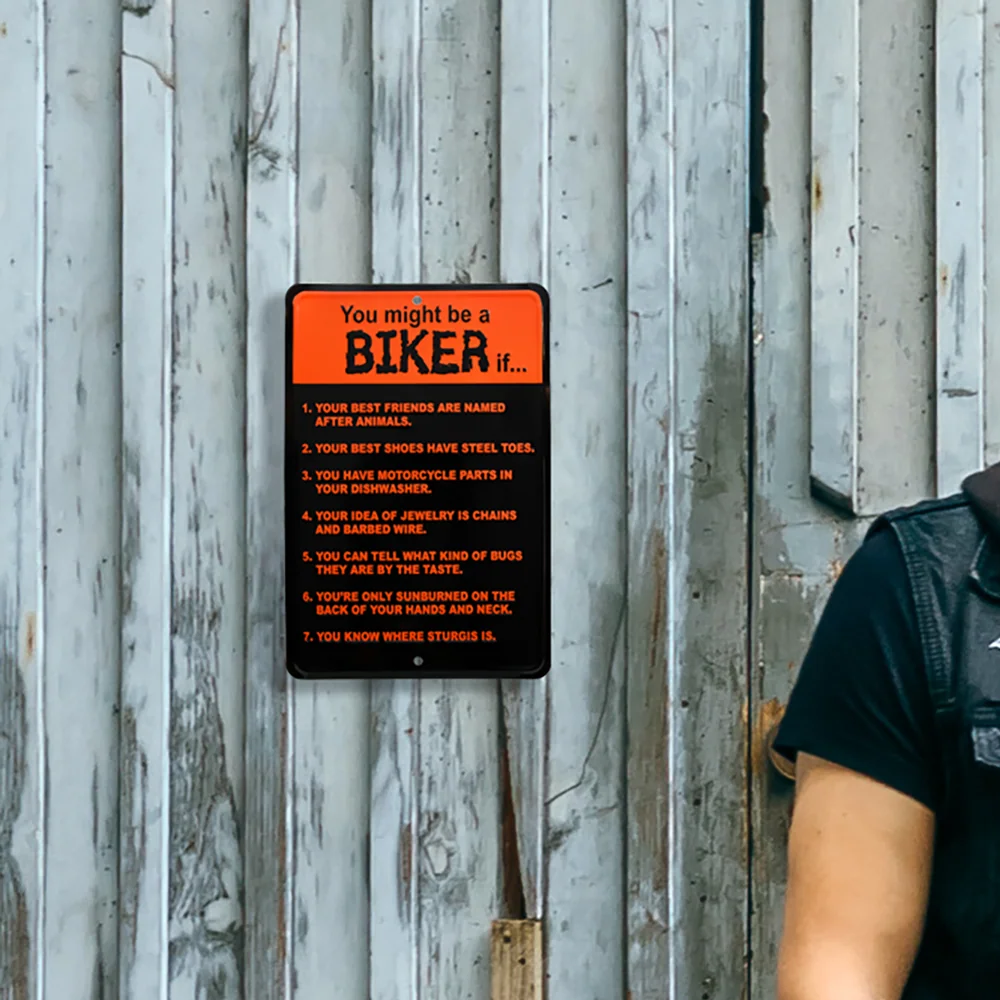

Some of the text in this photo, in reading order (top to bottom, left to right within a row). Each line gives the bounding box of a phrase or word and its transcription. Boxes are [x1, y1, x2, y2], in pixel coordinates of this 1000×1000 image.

[341, 305, 490, 328] You might be a
[345, 329, 527, 375] BIKER if...
[303, 402, 506, 413] 1. YOUR BEST FRIENDS ARE NAMED
[315, 416, 412, 427] AFTER ANIMALS.
[302, 443, 535, 454] 2. YOUR BEST SHOES HAVE STEEL TOES.
[302, 470, 512, 481] 3. YOU HAVE MOTORCYCLE PARTS IN
[315, 483, 432, 494] YOUR DISHWASHER.
[302, 510, 517, 521] 4. YOUR IDEA OF JEWELRY IS CHAINS
[315, 524, 426, 534] AND BARBED WIRE.
[303, 550, 523, 561] 5. YOU CAN TELL WHAT KIND OF BUGS
[316, 564, 463, 575] THEY ARE BY THE TASTE.
[303, 591, 515, 602] 6. YOU'RE ONLY SUNBURNED ON THE
[316, 604, 512, 615] BACK OF YOUR HANDS AND NECK.
[303, 631, 496, 642] 7. YOU KNOW WHERE STURGIS IS.
